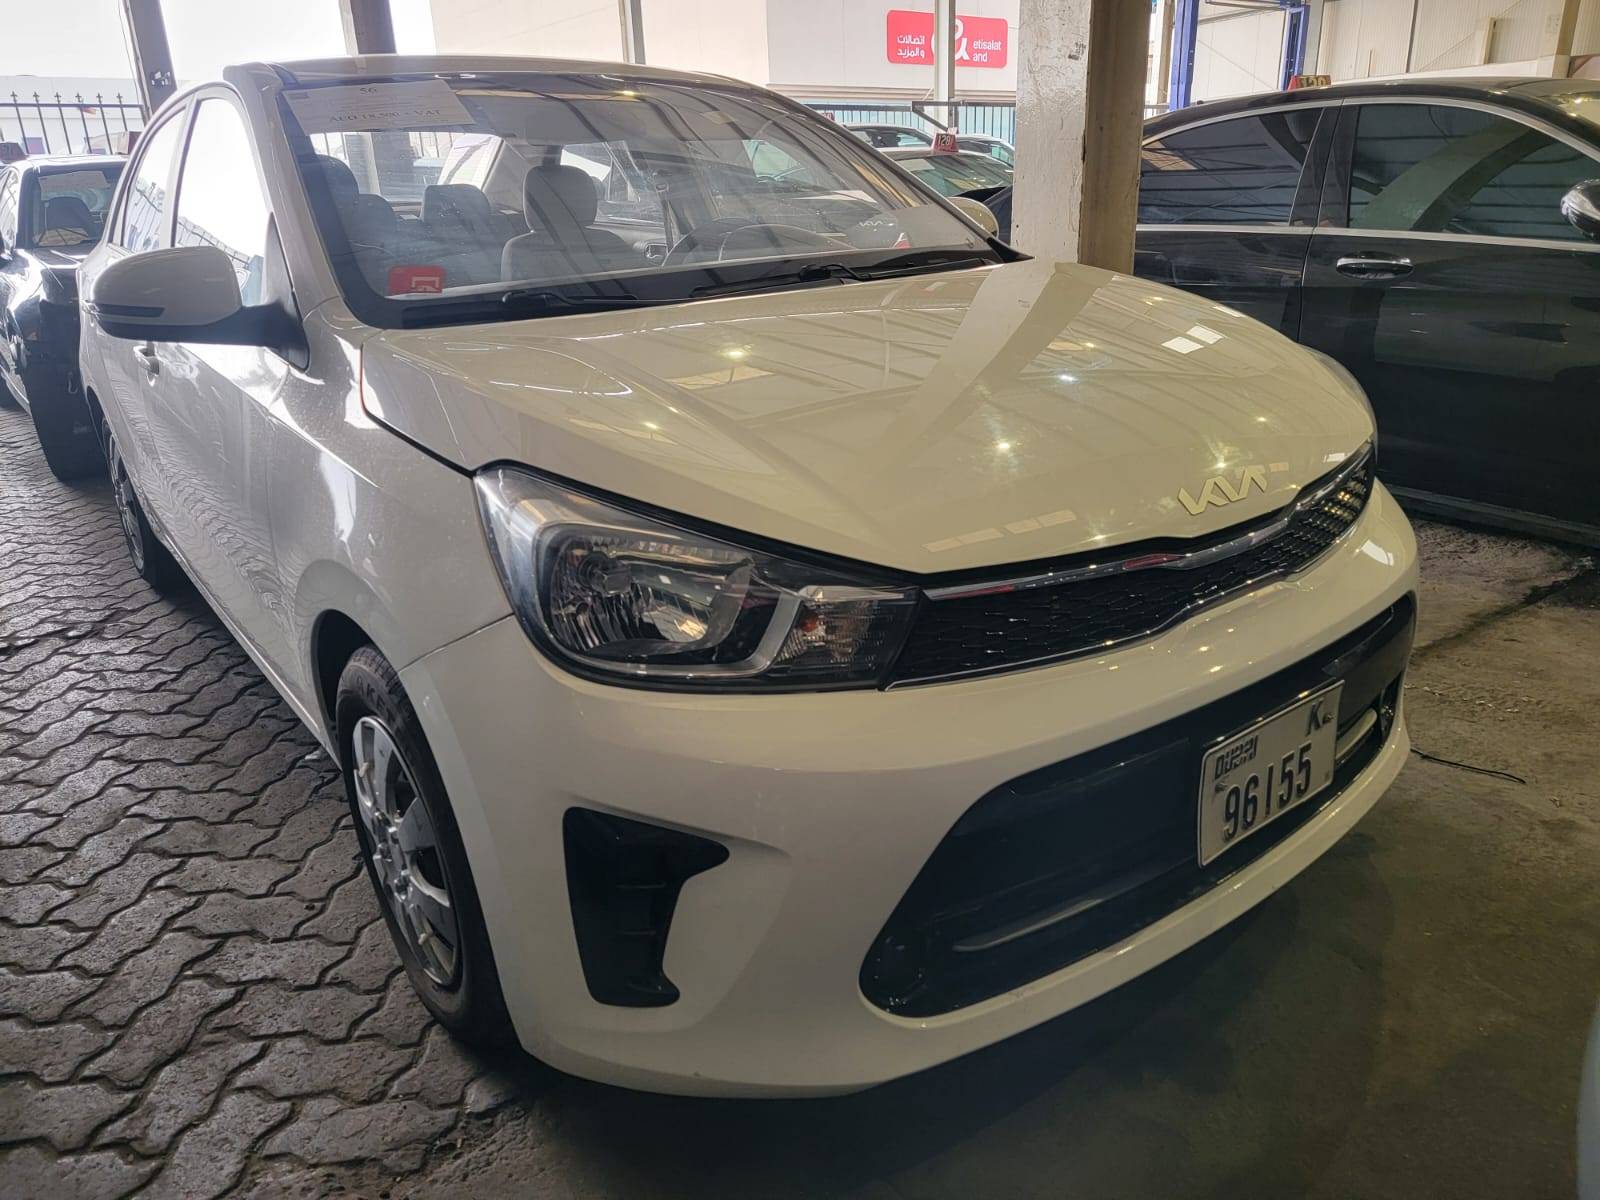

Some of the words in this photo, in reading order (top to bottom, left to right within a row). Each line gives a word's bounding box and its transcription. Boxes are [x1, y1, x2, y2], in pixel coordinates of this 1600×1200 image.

[897, 34, 925, 45] اتصالات
[972, 39, 1002, 50] etisalat
[972, 51, 988, 63] and
[1177, 465, 1267, 516] KIA
[1306, 698, 1324, 737] K
[1223, 742, 1312, 843] 96155
